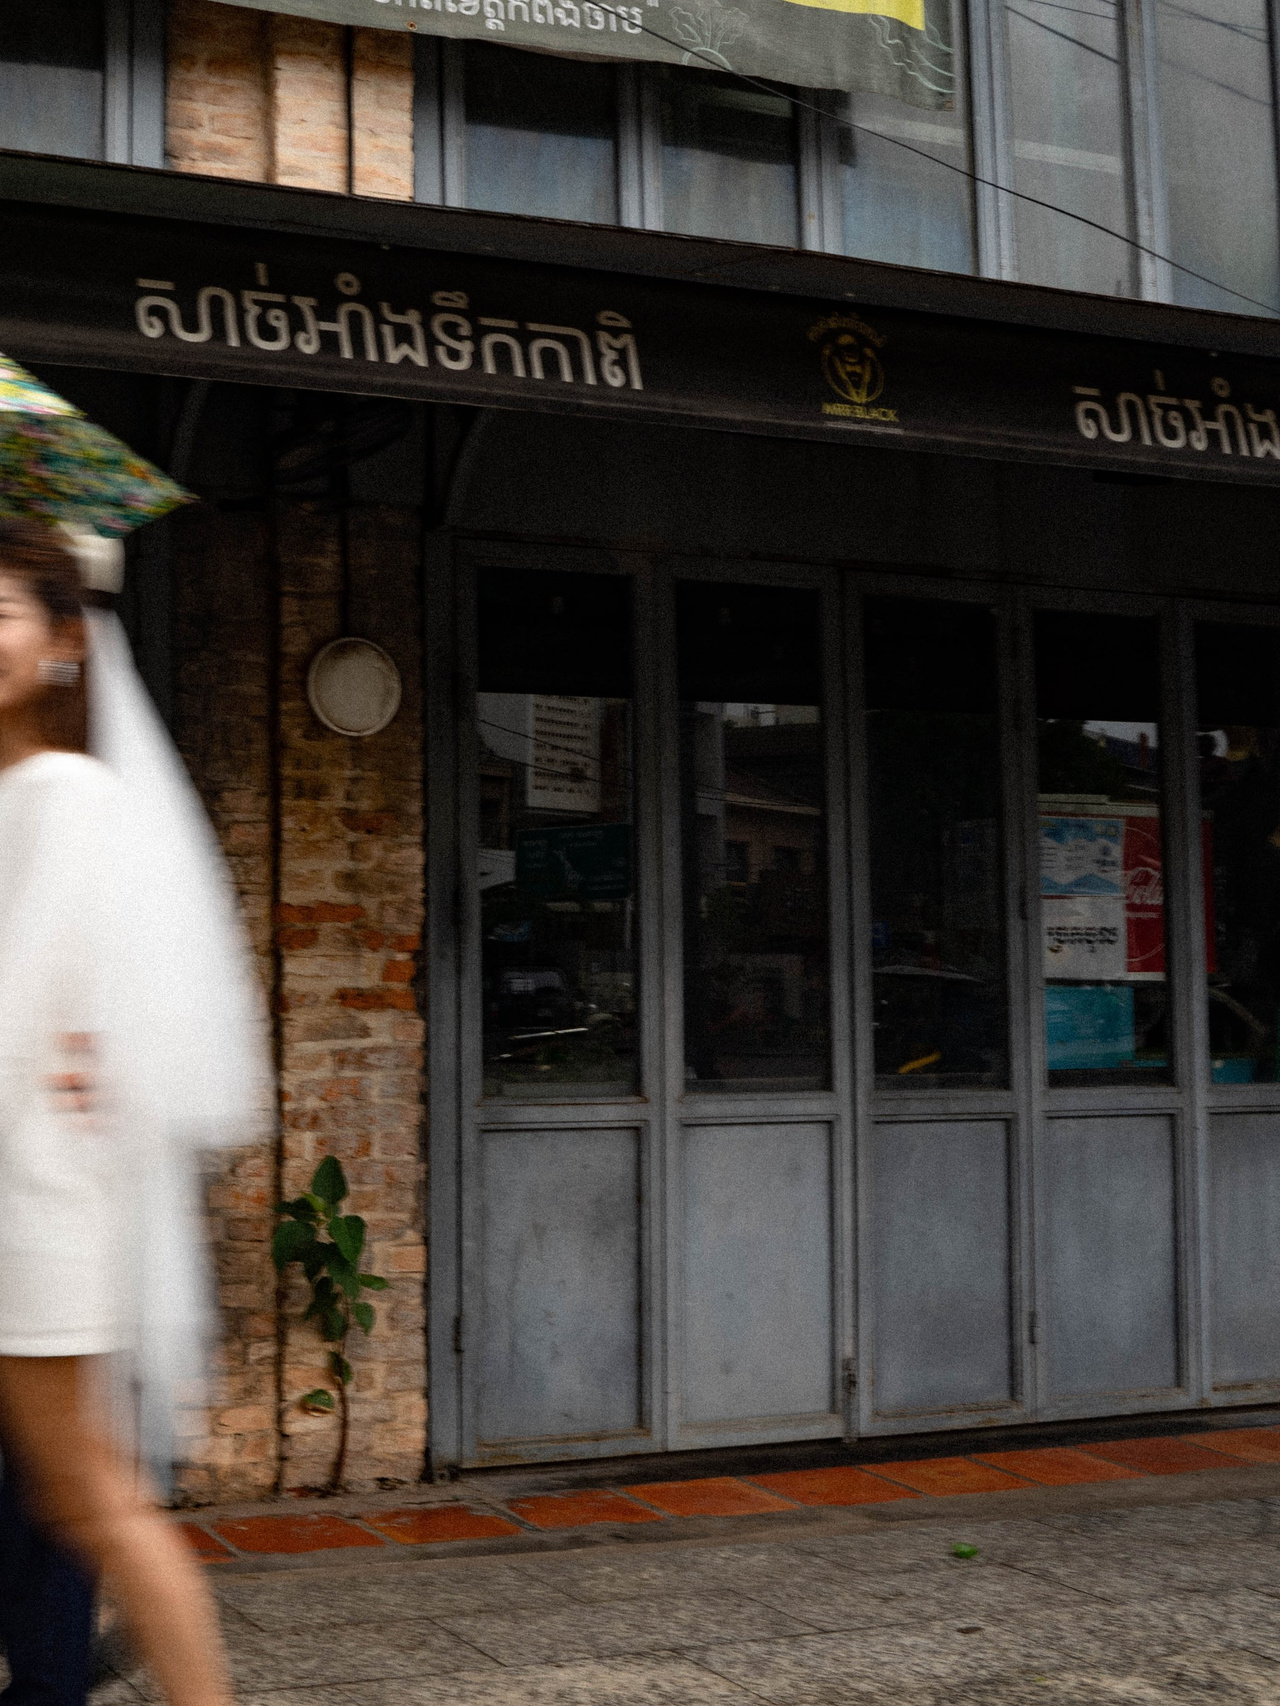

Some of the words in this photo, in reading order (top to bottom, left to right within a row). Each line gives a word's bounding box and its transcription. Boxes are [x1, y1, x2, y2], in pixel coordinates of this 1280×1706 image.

[134, 262, 645, 391] សាច់អាំងទឹកកាពិ
